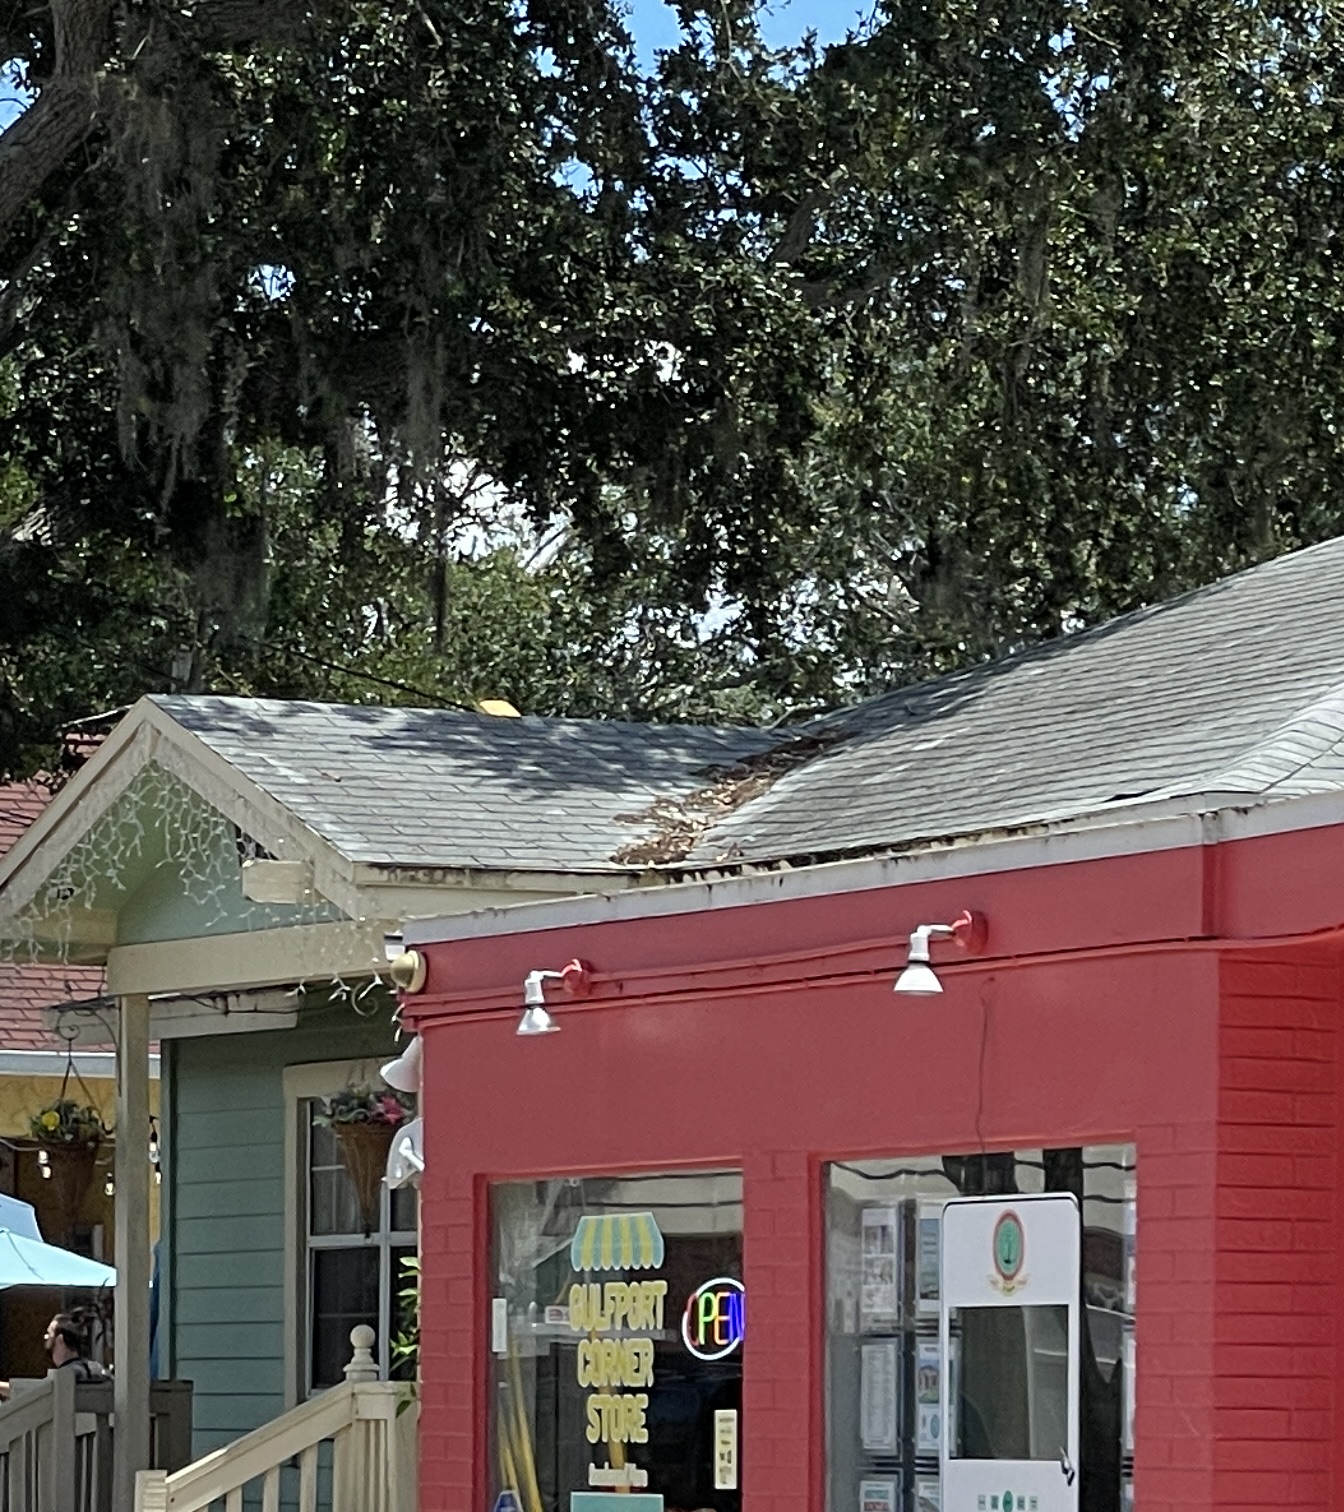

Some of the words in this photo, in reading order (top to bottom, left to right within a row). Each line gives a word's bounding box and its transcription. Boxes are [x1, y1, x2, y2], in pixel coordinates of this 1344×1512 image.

[568, 1279, 668, 1332] GULFPORT
[577, 1337, 655, 1388] CORNER
[586, 1393, 649, 1444] STORE
